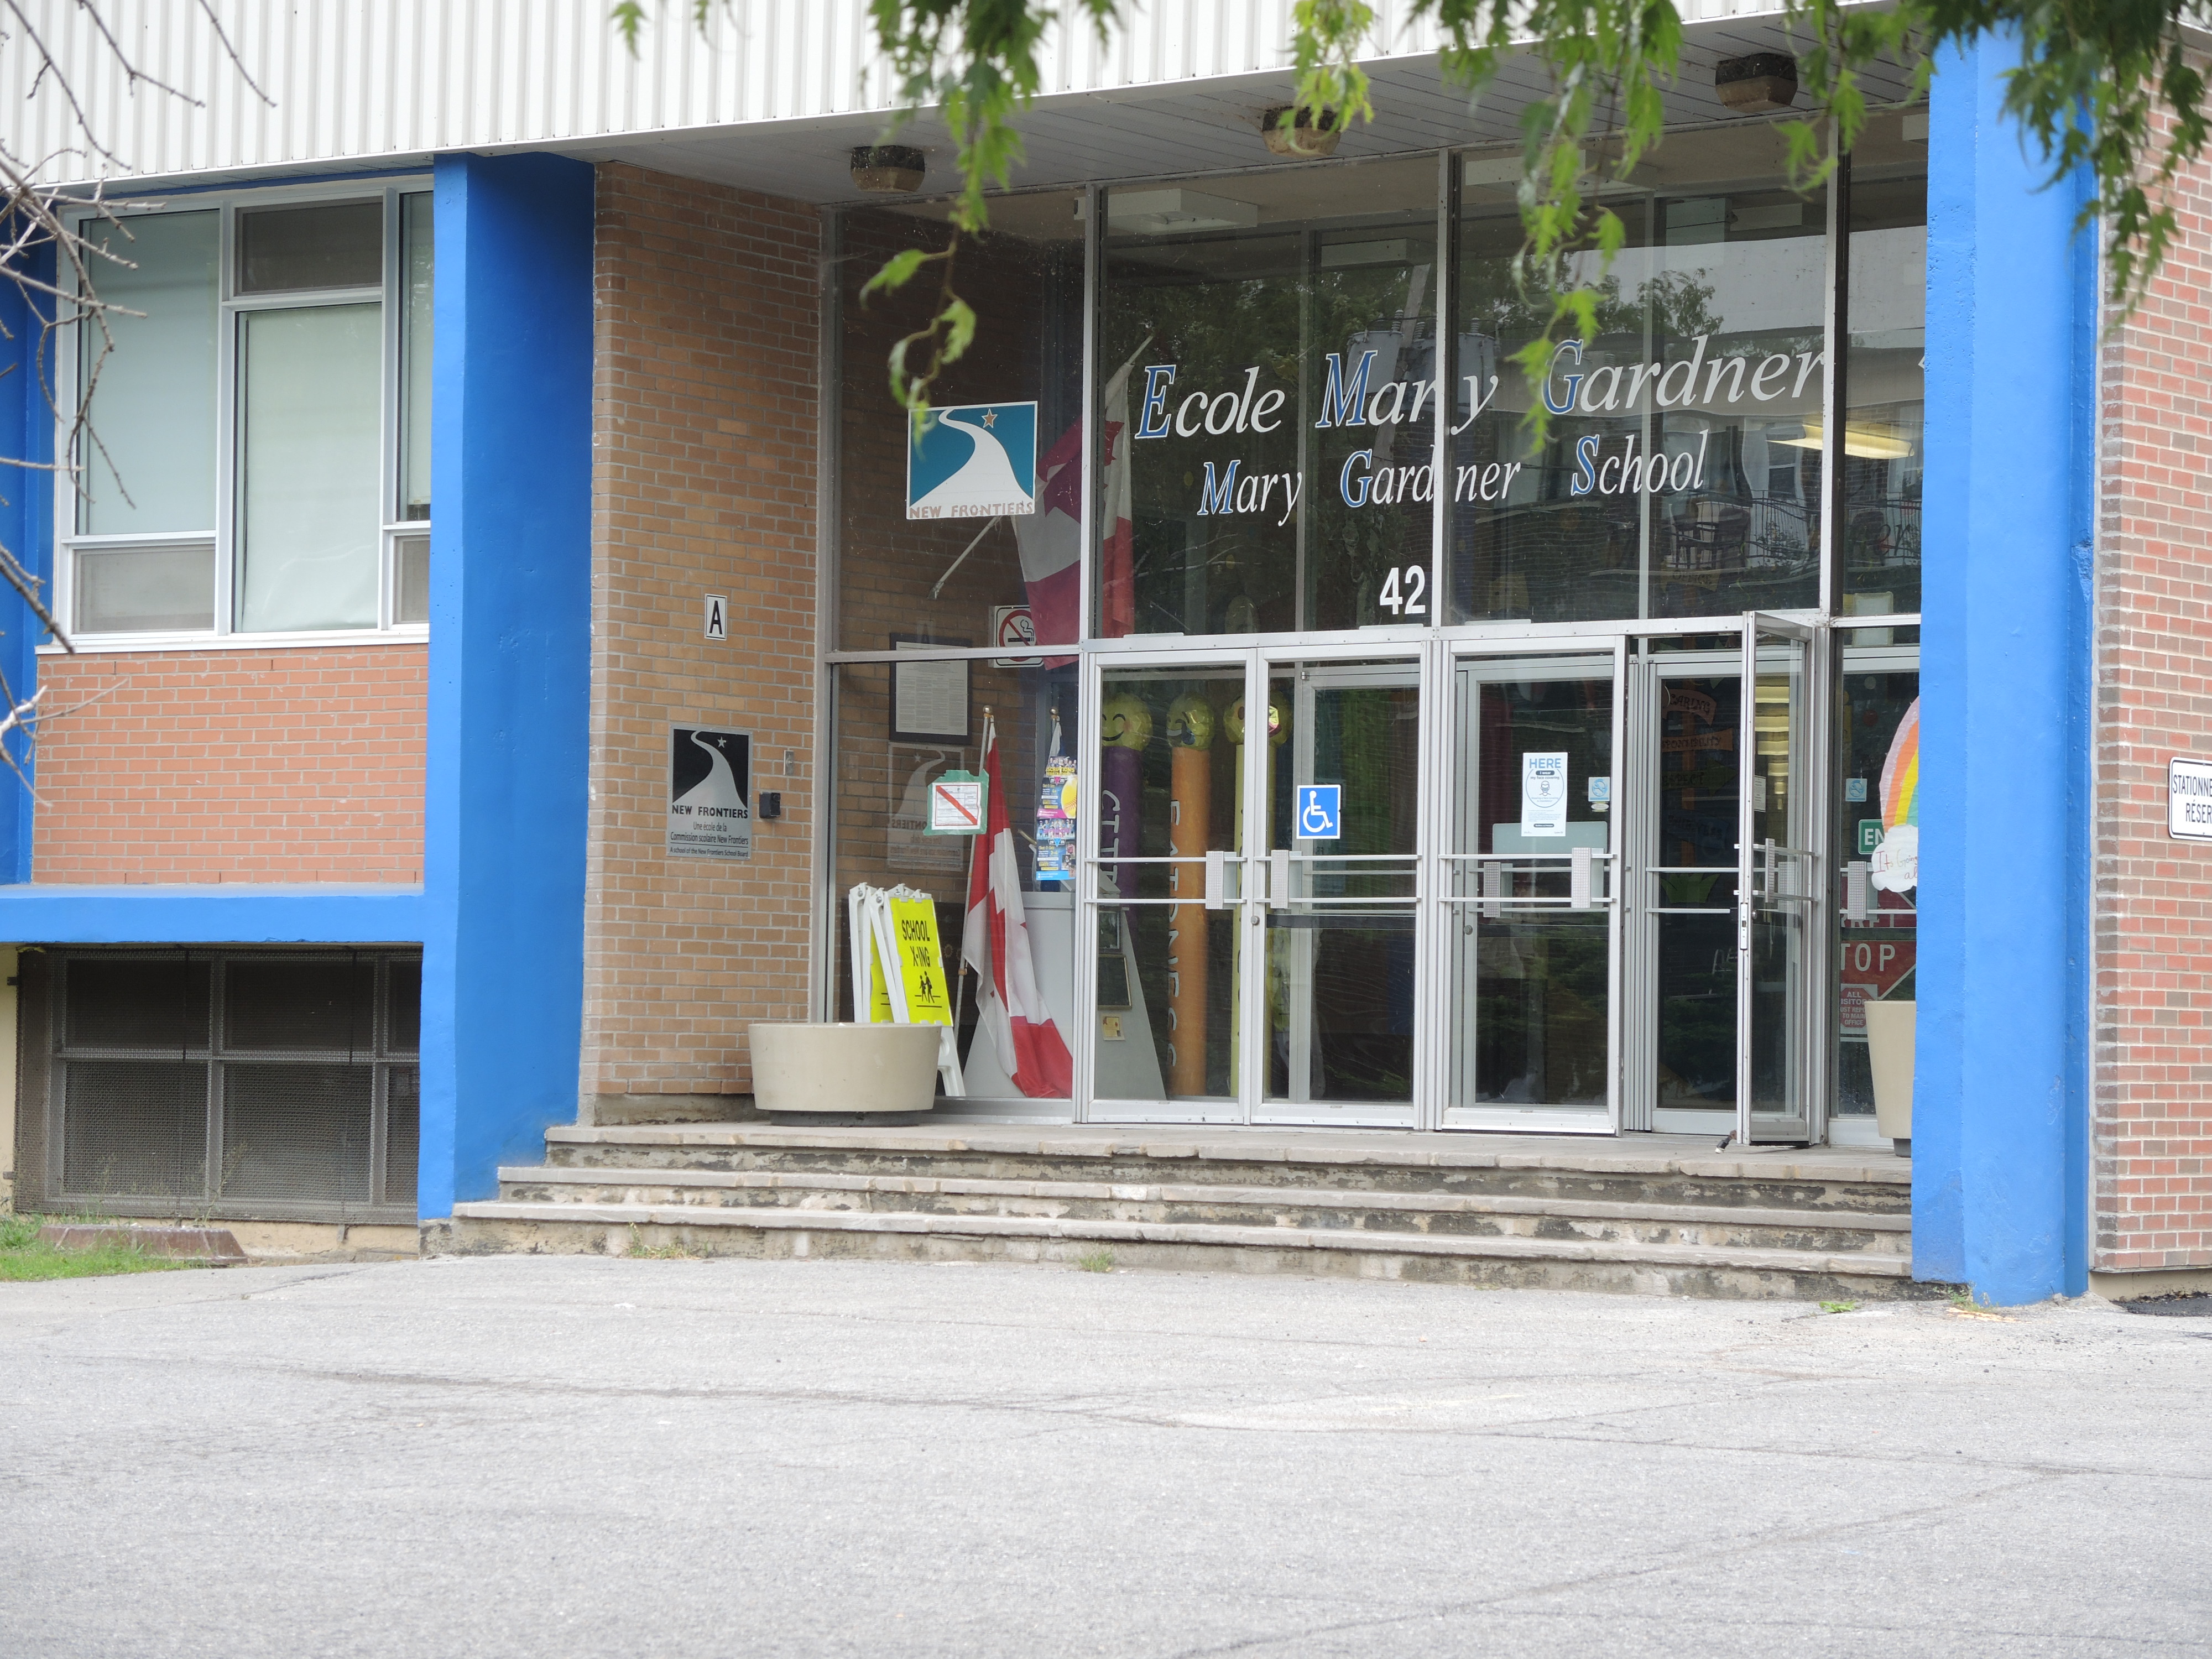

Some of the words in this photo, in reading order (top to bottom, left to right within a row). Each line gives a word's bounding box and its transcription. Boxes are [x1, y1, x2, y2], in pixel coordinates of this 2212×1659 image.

[1135, 365, 1285, 439] Ecole
[1315, 350, 1498, 435] Mary
[1542, 335, 1825, 415] Gardner
[1197, 460, 1302, 526] Mary
[1340, 445, 1520, 507] Gardner
[1571, 429, 1709, 495] School
[909, 505, 941, 519] NEW
[951, 502, 1033, 517] FRONTIERS
[1379, 565, 1426, 615] 42
[709, 600, 723, 635] A
[1529, 758, 1561, 769] HERE
[672, 805, 692, 815] NEW
[698, 806, 748, 818] FRONTIERS
[693, 821, 702, 830] Une
[703, 822, 715, 831] école
[716, 822, 722, 832] de
[723, 822, 727, 832] la
[1864, 828, 1885, 846] EN
[670, 832, 698, 842] Commission
[699, 833, 716, 843] scolaire
[717, 834, 727, 843] New
[728, 836, 749, 845] Frontiers
[901, 920, 930, 941] SCHOOL
[910, 946, 931, 967] X-ING
[1840, 943, 1896, 972] TOP
